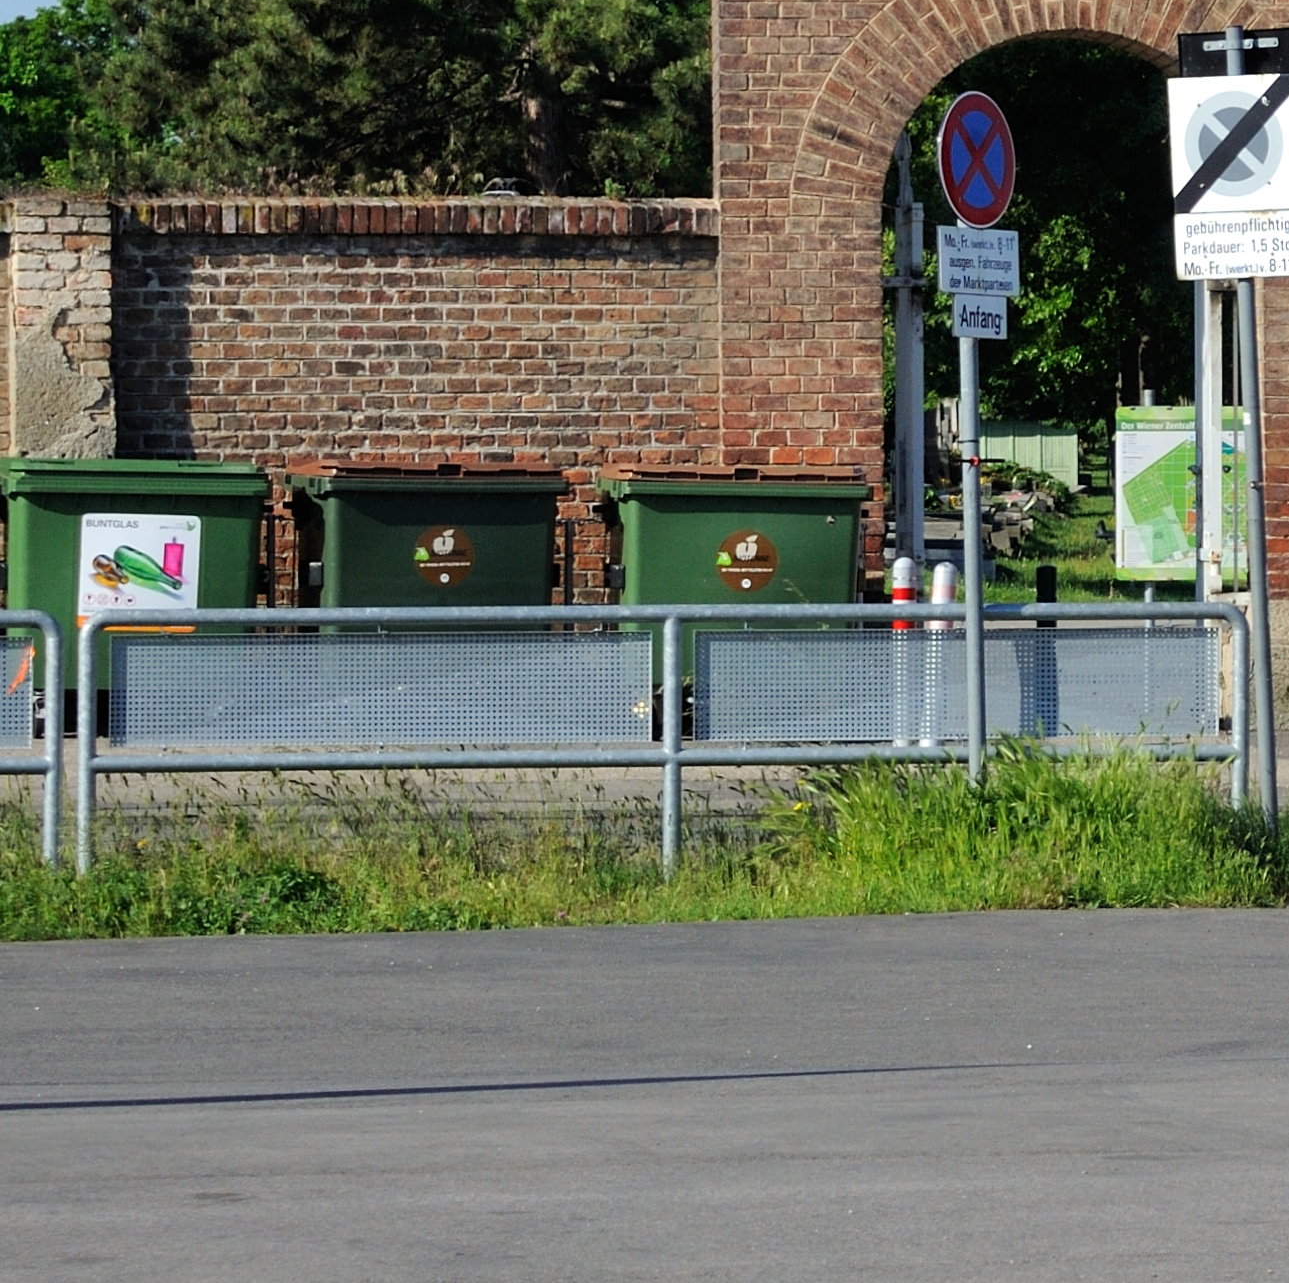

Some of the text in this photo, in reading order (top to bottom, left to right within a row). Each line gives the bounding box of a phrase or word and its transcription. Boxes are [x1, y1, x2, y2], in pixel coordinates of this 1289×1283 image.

[1183, 241, 1245, 255] Parkdauer:
[1251, 238, 1268, 254] 1,5
[949, 255, 1013, 274] ausgen. Fahrzeuge
[949, 274, 961, 288] der
[960, 304, 1001, 335] Anfang
[1121, 421, 1134, 430] Der
[1136, 421, 1164, 430] Wiener
[86, 519, 139, 528] BUNTGLAS
